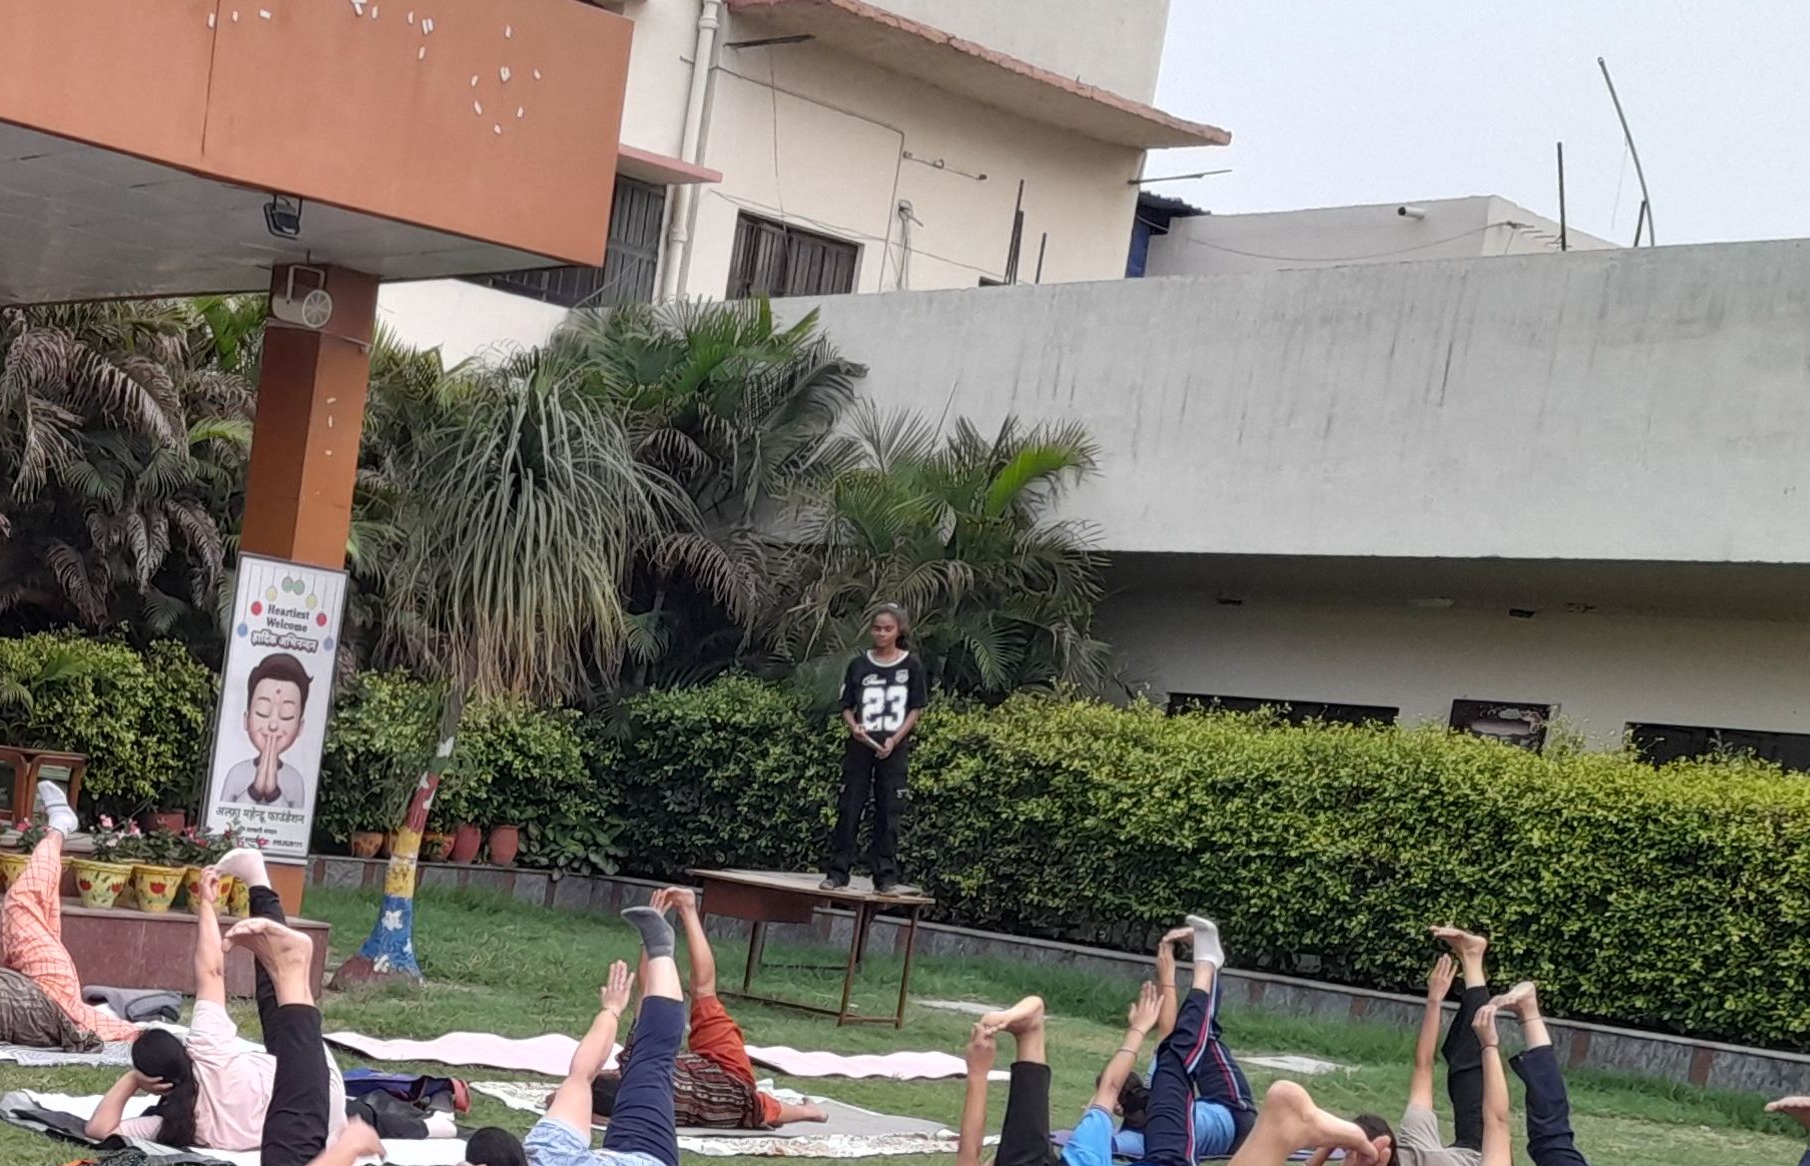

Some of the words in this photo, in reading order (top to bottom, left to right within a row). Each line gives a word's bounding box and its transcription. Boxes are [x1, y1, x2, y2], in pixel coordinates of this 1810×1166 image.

[267, 604, 310, 620] Heartiest
[266, 617, 308, 632] Welcome
[862, 685, 909, 731] 23
